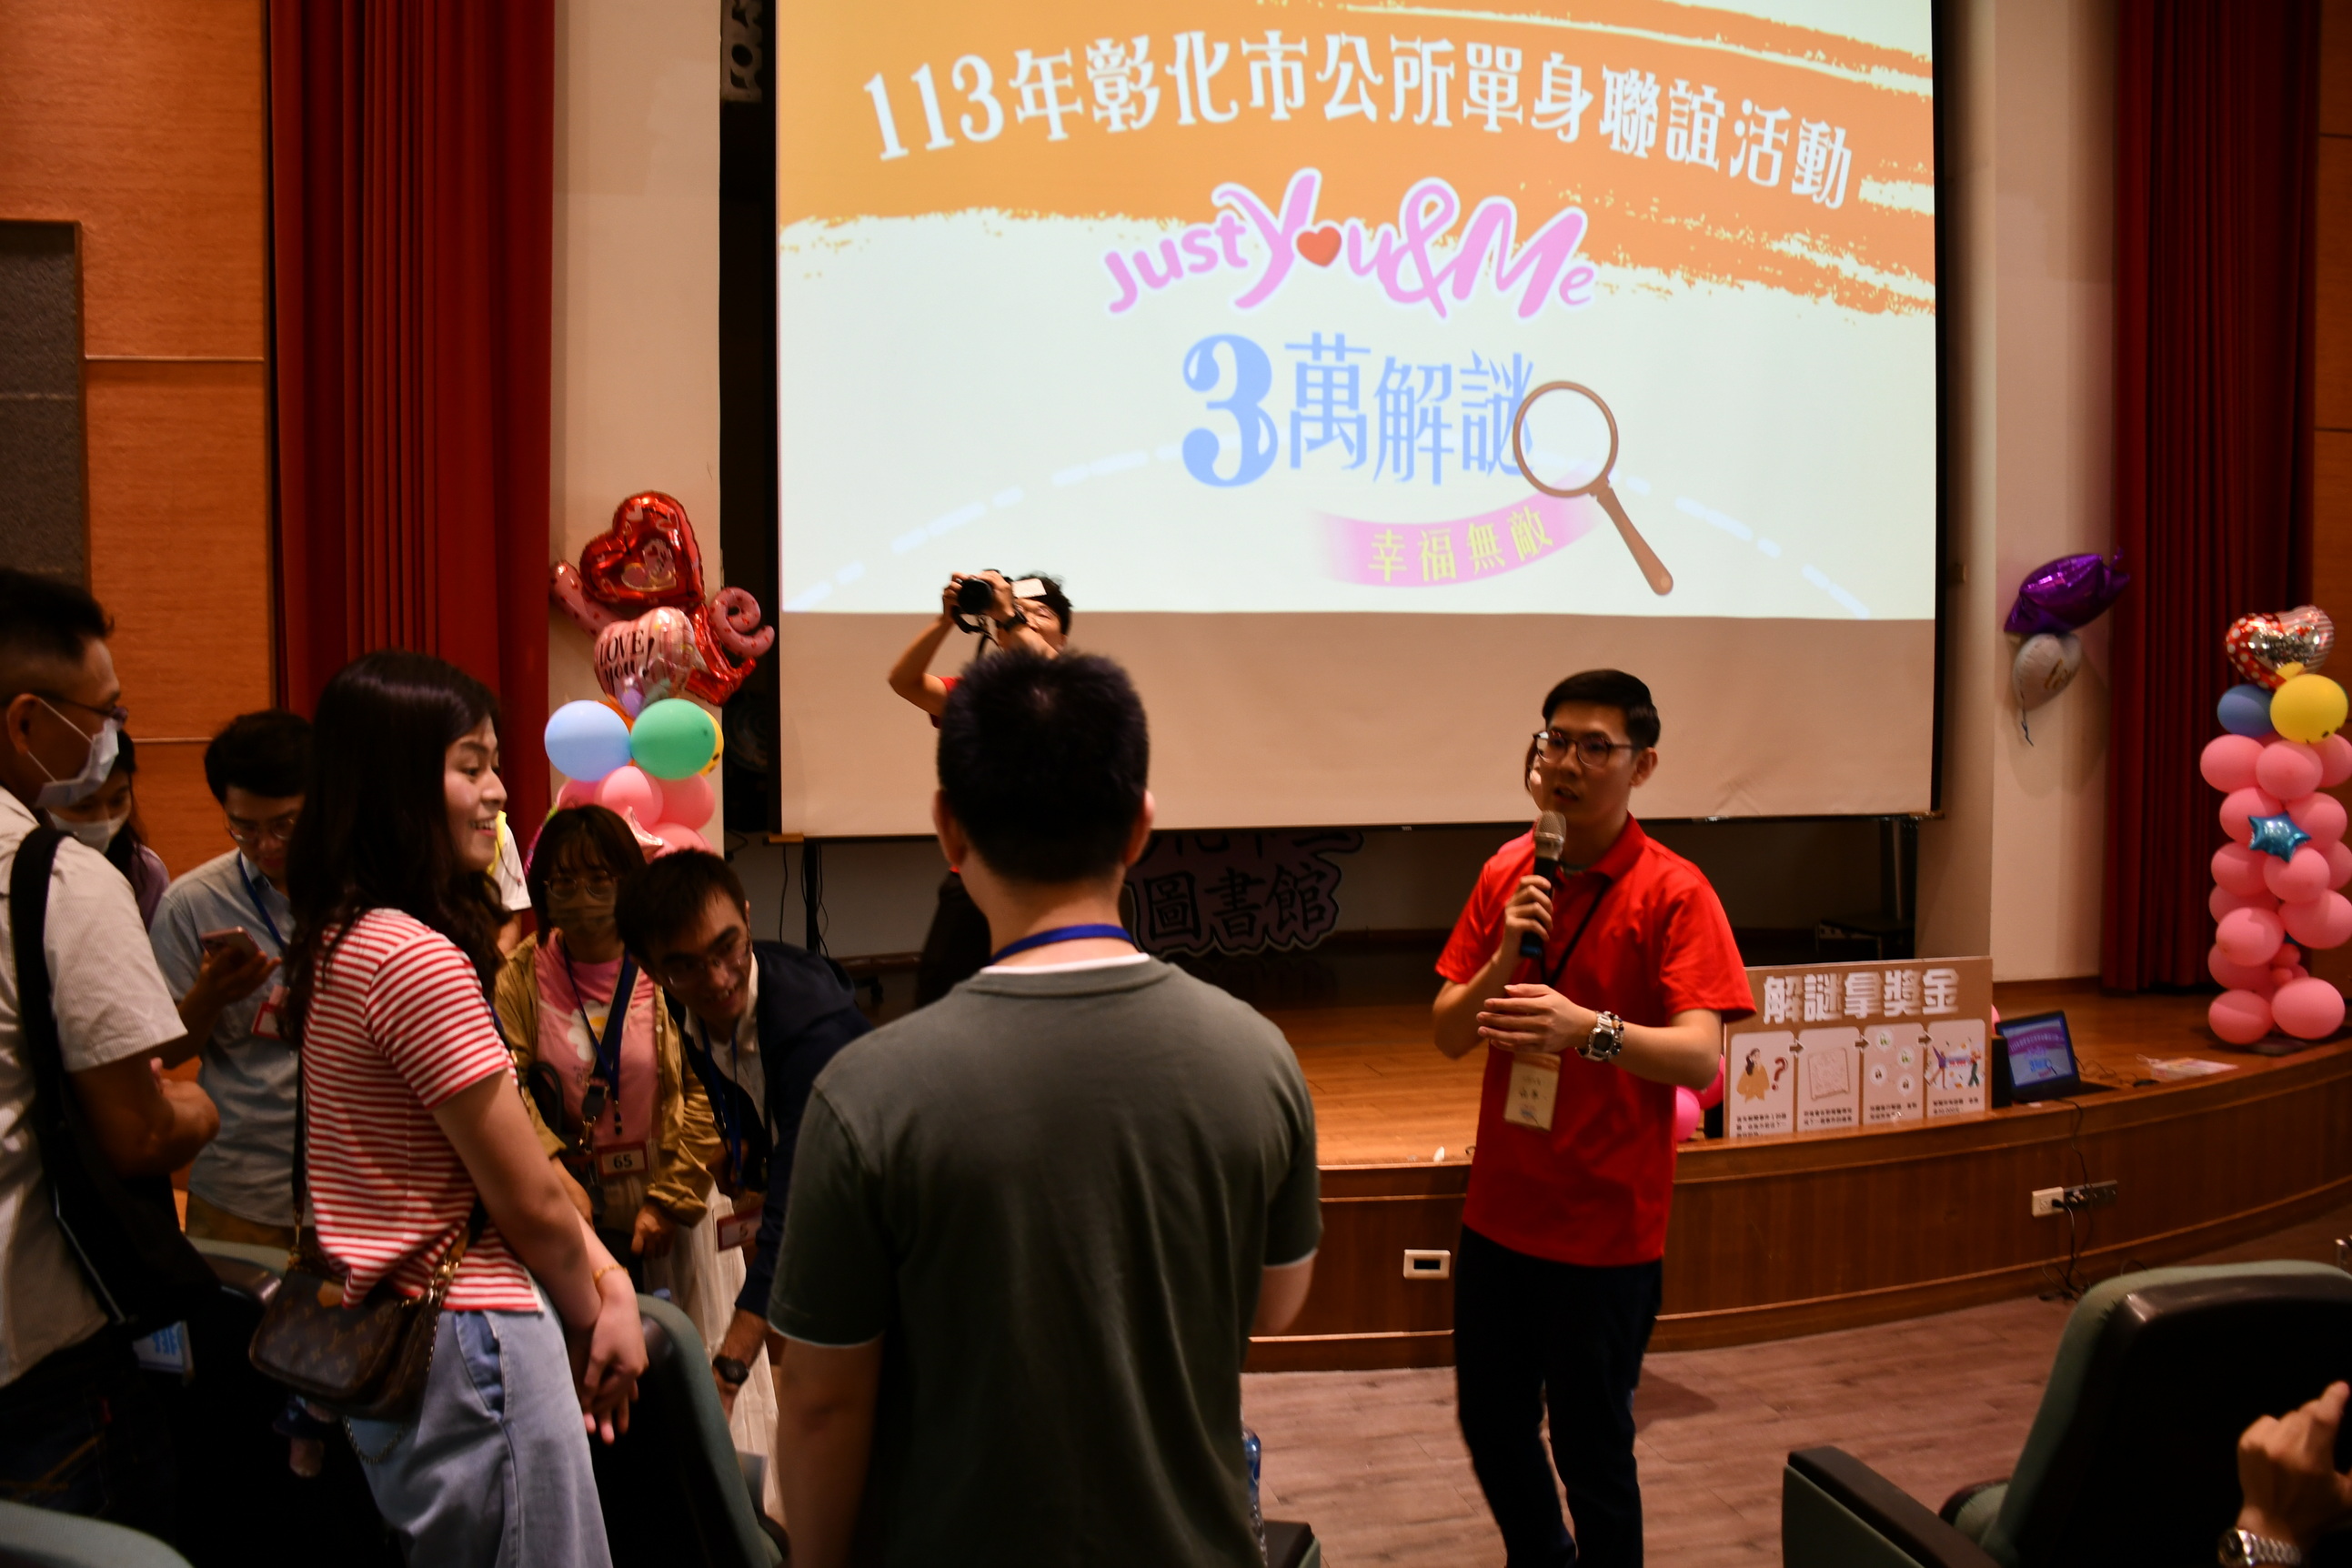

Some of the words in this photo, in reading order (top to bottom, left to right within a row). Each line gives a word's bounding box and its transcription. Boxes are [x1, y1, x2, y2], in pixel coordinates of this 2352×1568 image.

[862, 30, 1854, 209] 113年彰化市公所單身聯誼活動
[1181, 331, 1535, 488] 3萬解謎
[1368, 506, 1553, 582] 幸福無敵
[598, 629, 645, 668] LOVE
[1142, 861, 1328, 941] 圖書館
[1763, 968, 1959, 1025] 解謎拿獎金
[612, 1153, 633, 1169] 65
